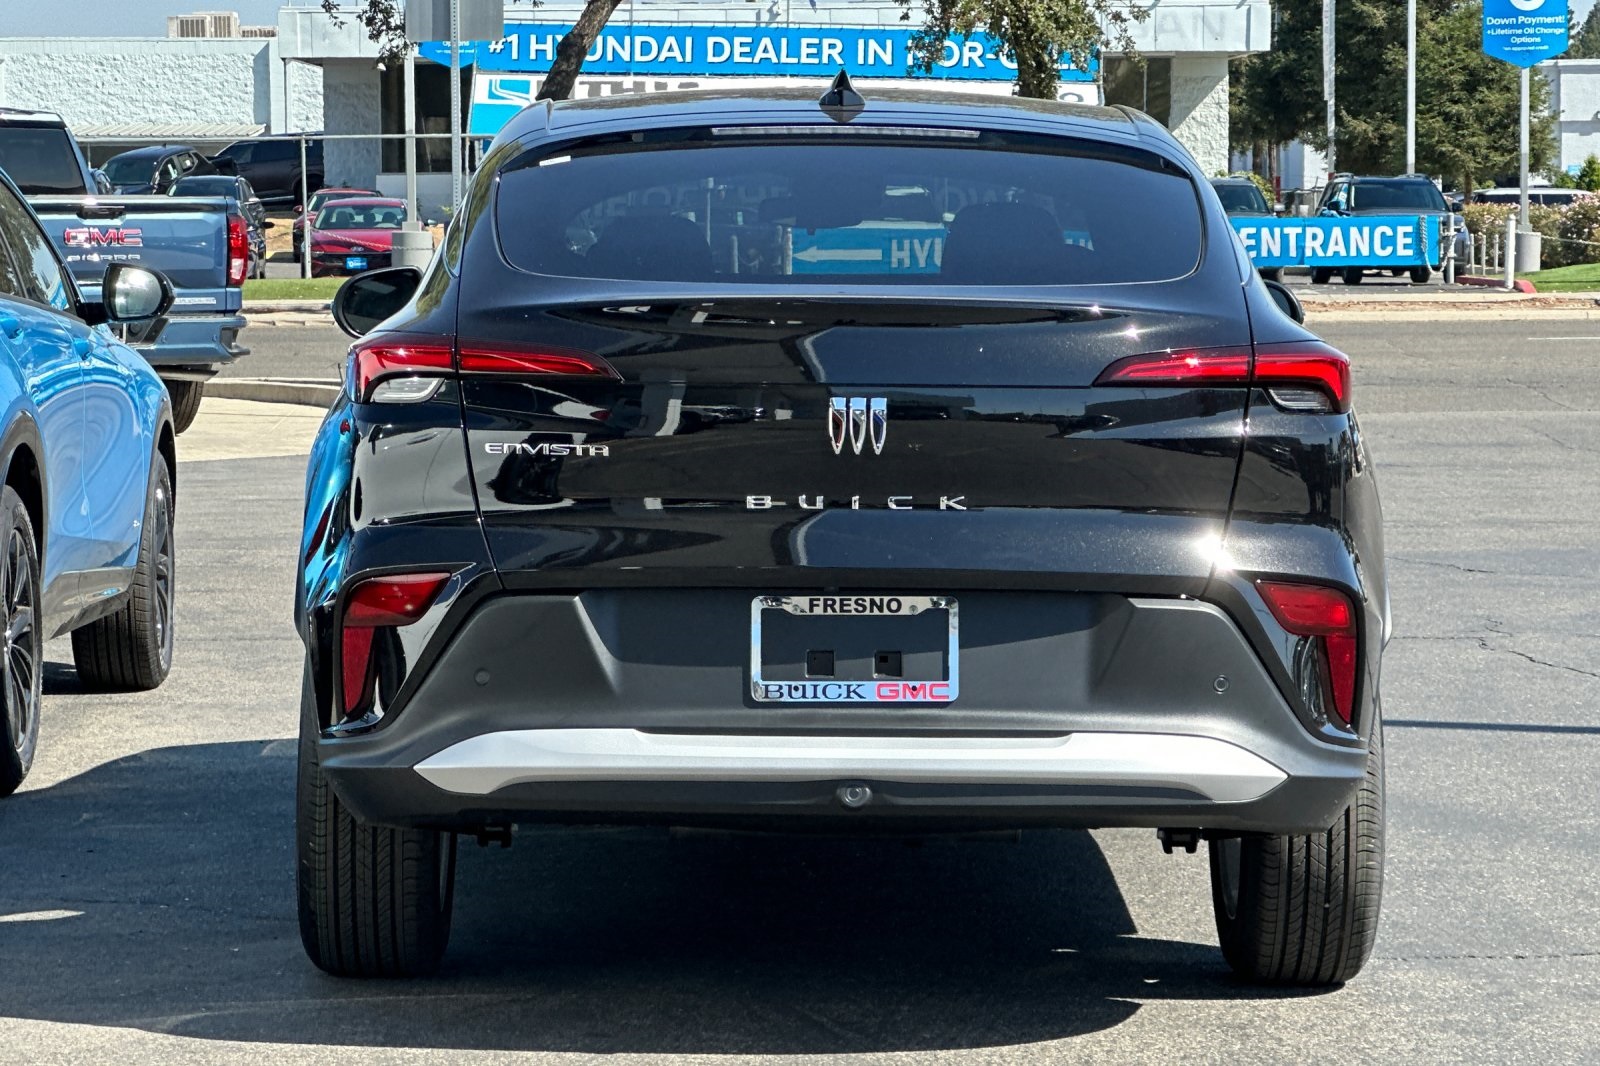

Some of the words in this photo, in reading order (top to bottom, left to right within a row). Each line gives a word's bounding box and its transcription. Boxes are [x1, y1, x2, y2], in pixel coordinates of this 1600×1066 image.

[1487, 17, 1516, 25] Down
[1518, 15, 1565, 26] Payment!
[1510, 36, 1541, 44] Options
[488, 33, 519, 60] #1
[529, 34, 693, 63] HUNDAI
[706, 37, 844, 65] DEALER
[857, 39, 893, 65] IN
[64, 228, 143, 248] GMC
[1239, 226, 1414, 258] ENTRANCE
[484, 442, 609, 456] ENVISTA
[746, 494, 967, 510] BUICK
[808, 598, 902, 613] FRESNO
[763, 683, 866, 700] BUICK
[875, 683, 950, 700] GMC
